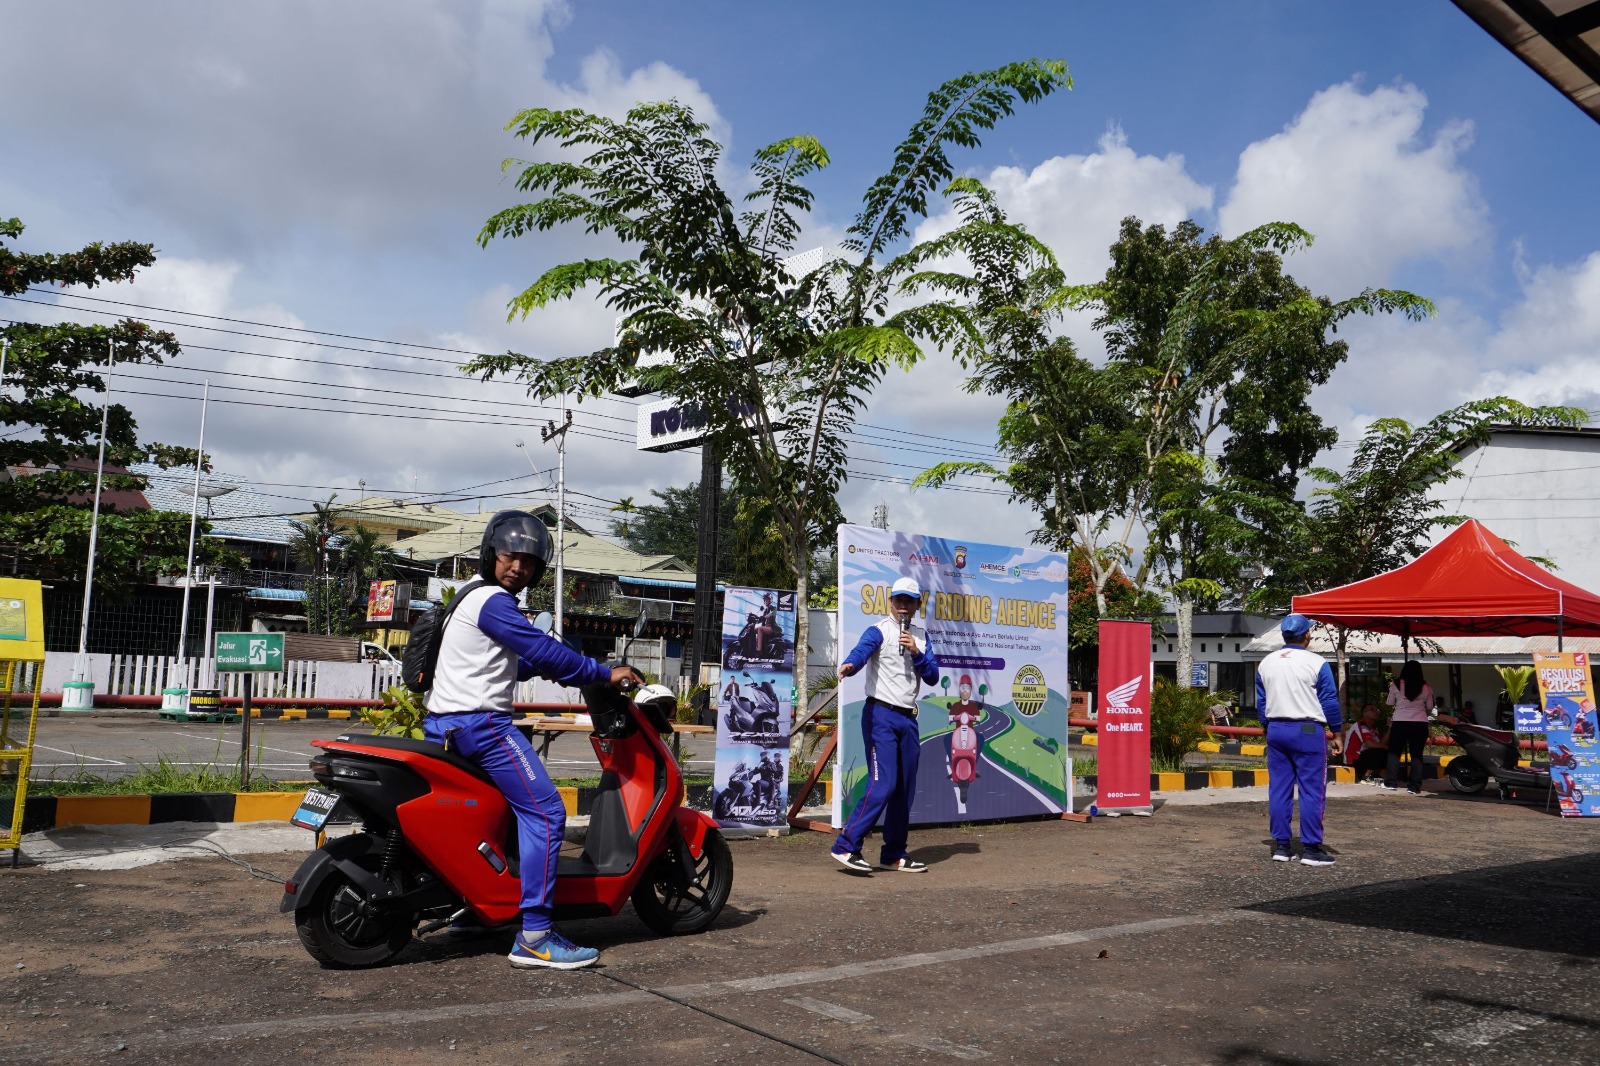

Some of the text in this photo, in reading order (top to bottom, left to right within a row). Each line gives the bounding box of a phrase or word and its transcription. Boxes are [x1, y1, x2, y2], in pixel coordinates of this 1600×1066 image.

[908, 553, 939, 564] AHM
[980, 562, 1006, 572] AHEMCE
[935, 591, 992, 624] RIDING
[996, 598, 1056, 630] AHEMCE
[1016, 667, 1042, 681] INDONESIA
[1540, 668, 1585, 680] RESOLUSI
[1548, 680, 1580, 692] 2025
[1106, 723, 1143, 732] One HEART.
